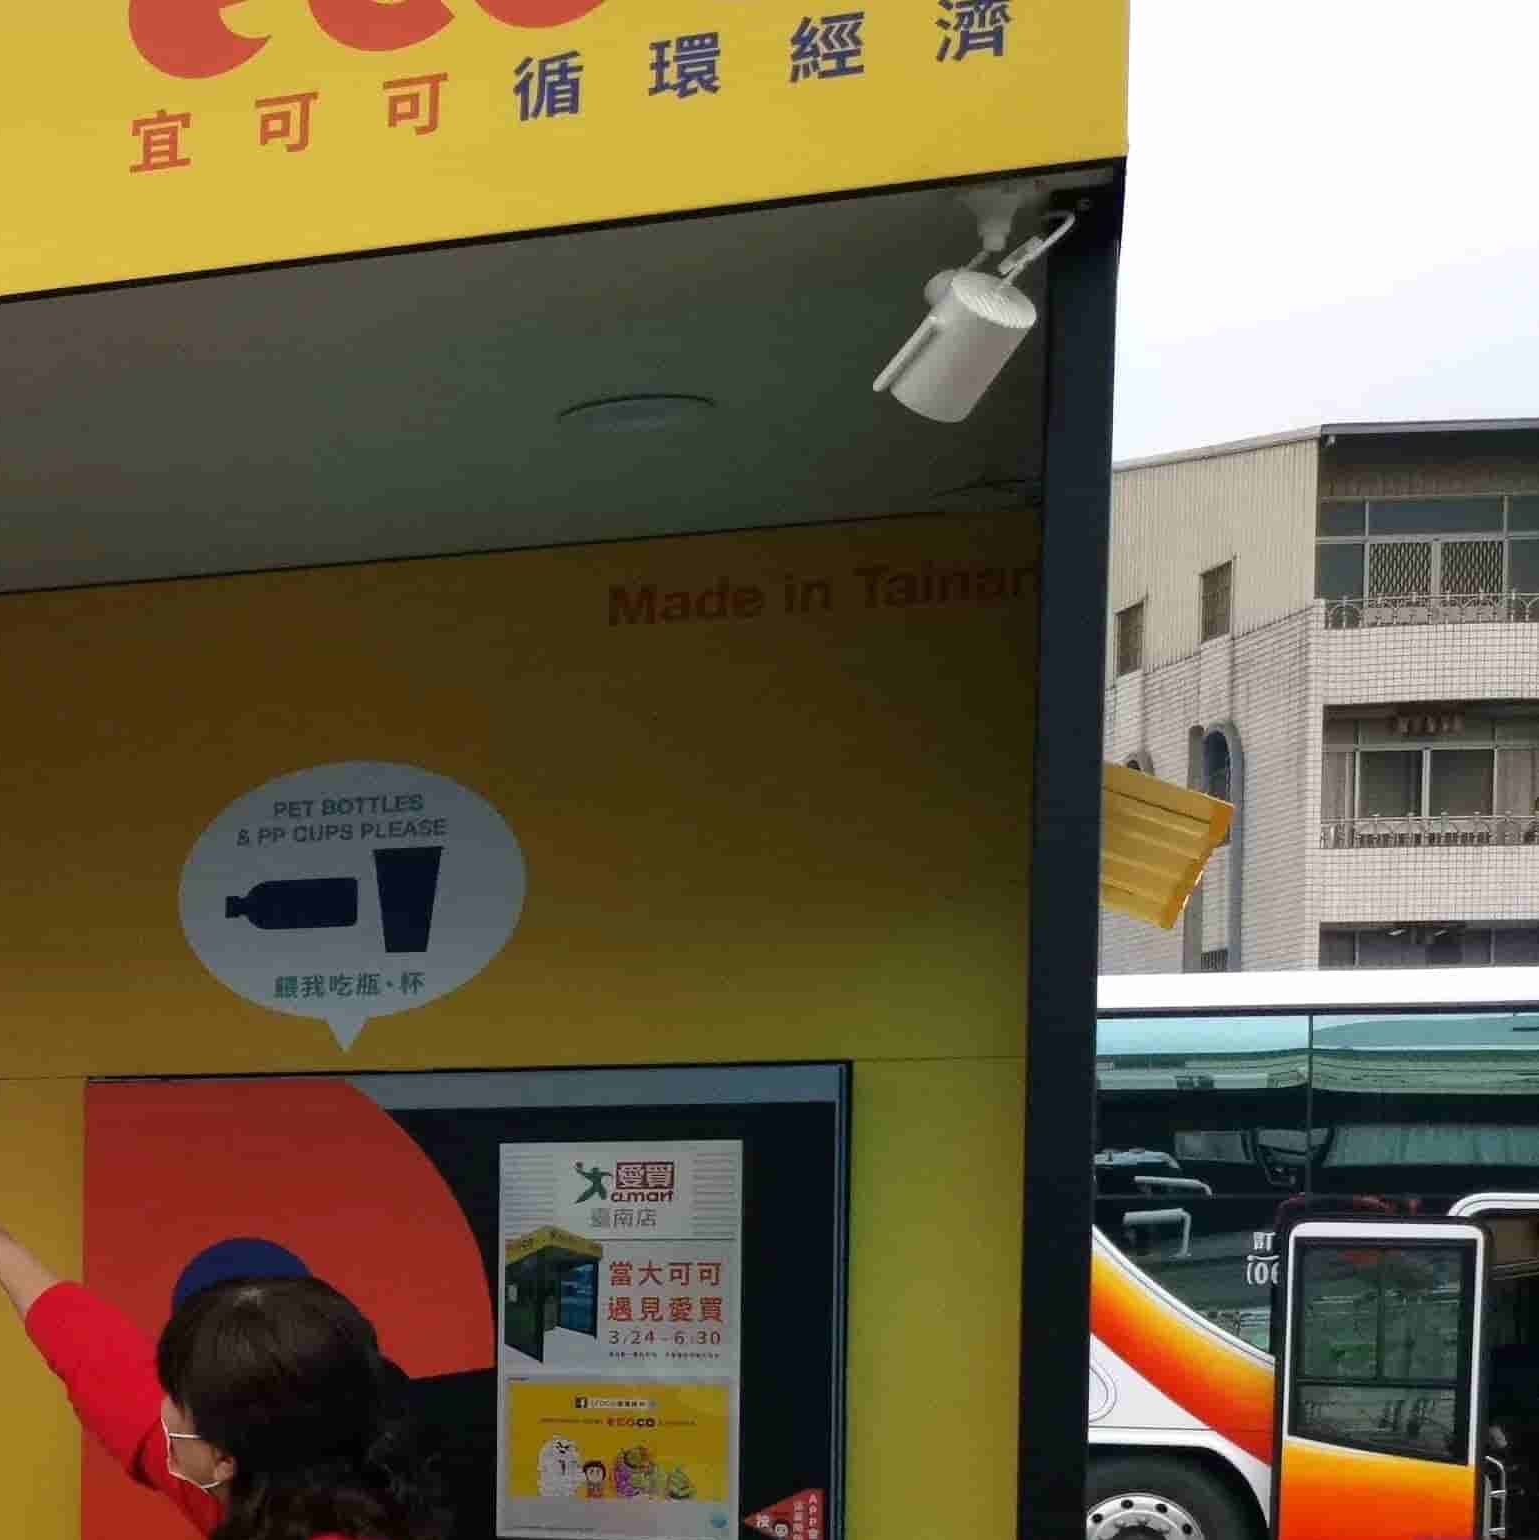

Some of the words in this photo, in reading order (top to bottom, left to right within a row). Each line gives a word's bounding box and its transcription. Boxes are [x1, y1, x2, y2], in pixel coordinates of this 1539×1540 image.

[129, 0, 1013, 174] 宜可可循環經濟
[609, 582, 764, 628] Made
[784, 569, 833, 615] in
[273, 801, 313, 817] PET
[321, 794, 424, 816] BOTTLES
[236, 829, 250, 847] &
[257, 827, 286, 845] PP
[293, 822, 354, 842] CUPS
[360, 818, 449, 841] PLEASE
[617, 1162, 674, 1190] 愛買
[608, 1261, 722, 1288] 當大可可
[607, 1296, 724, 1323] 遇見愛買
